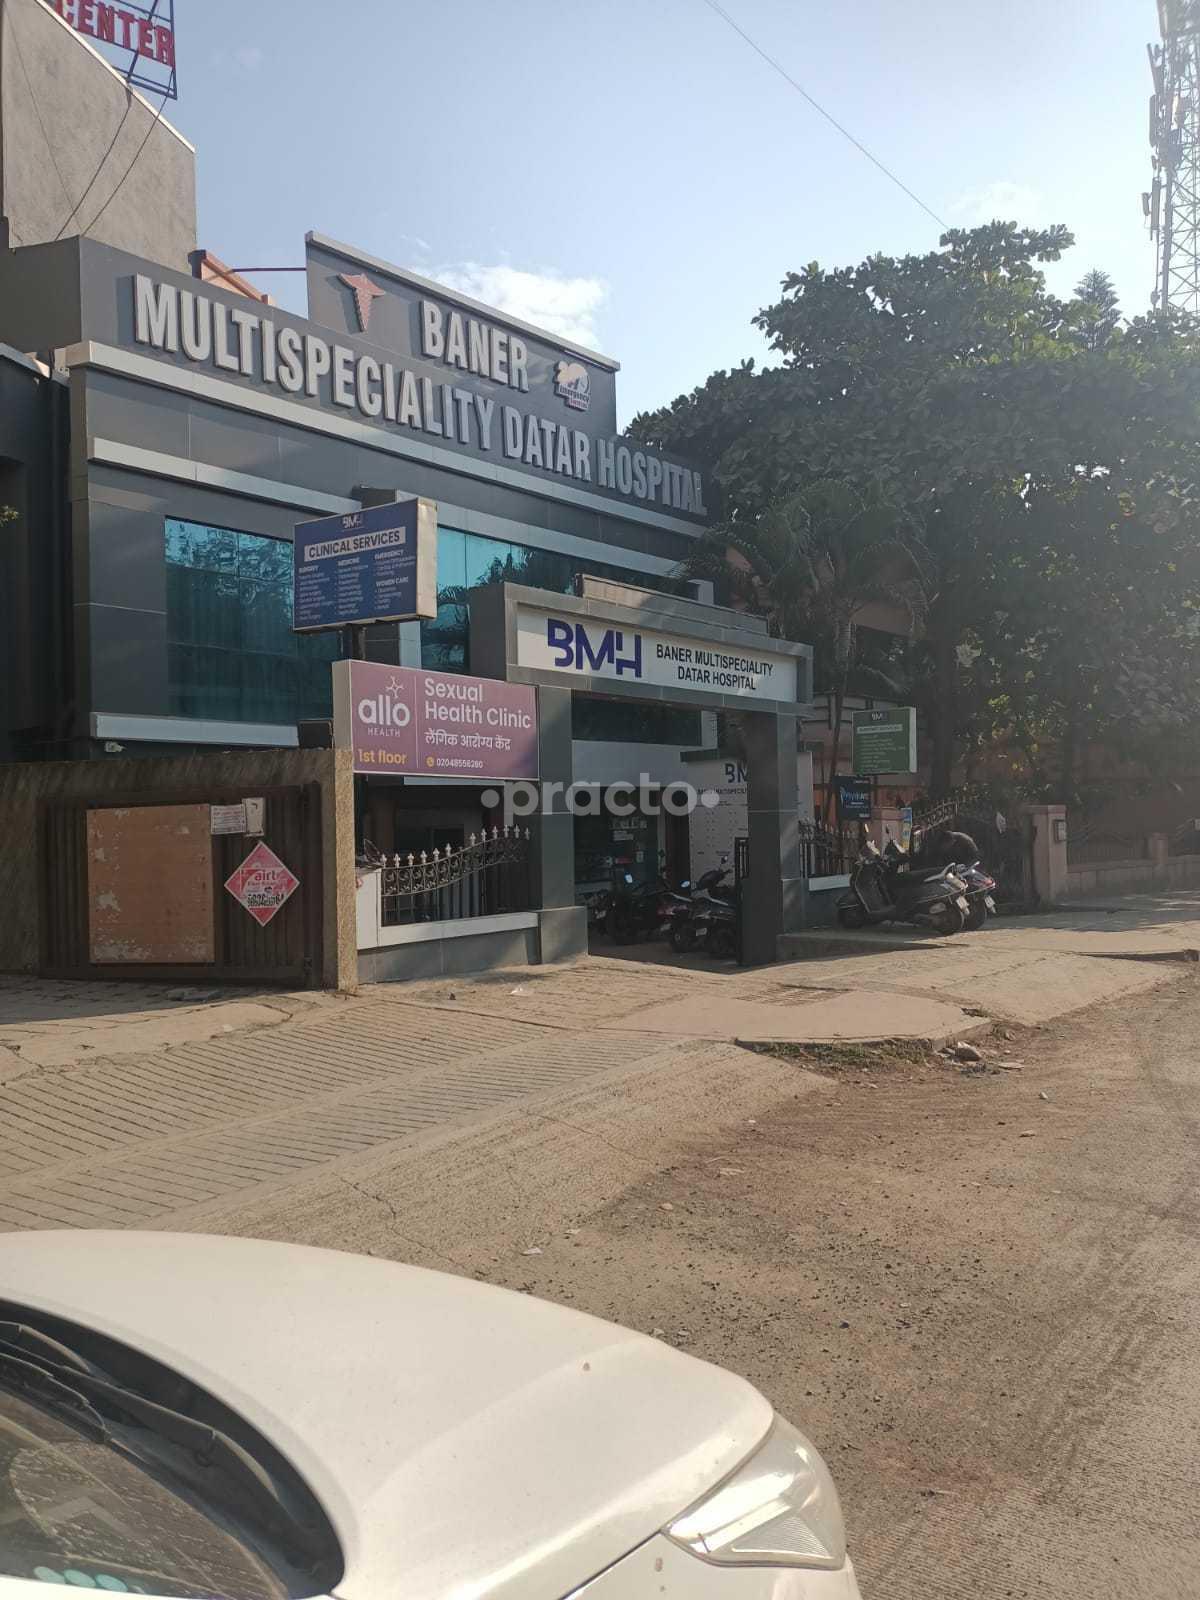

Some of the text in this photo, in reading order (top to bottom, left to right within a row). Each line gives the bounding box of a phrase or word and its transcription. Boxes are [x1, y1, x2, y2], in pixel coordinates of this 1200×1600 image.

[421, 300, 530, 392] BANER
[133, 272, 707, 516] MULTISPECIALITY DATAR HOSPITAL
[308, 531, 401, 559] CLINICAL SERVICES
[547, 618, 642, 678] BMH
[656, 644, 773, 677] BANER MULTISPECIALITY
[425, 678, 483, 702] Sexual
[677, 668, 757, 690] DATAR HOSPITAL
[358, 695, 410, 727] allo
[425, 702, 531, 729] Health Clinic
[367, 727, 401, 737] HEALTH
[358, 748, 407, 765] 1st floor
[725, 763, 749, 784] BM
